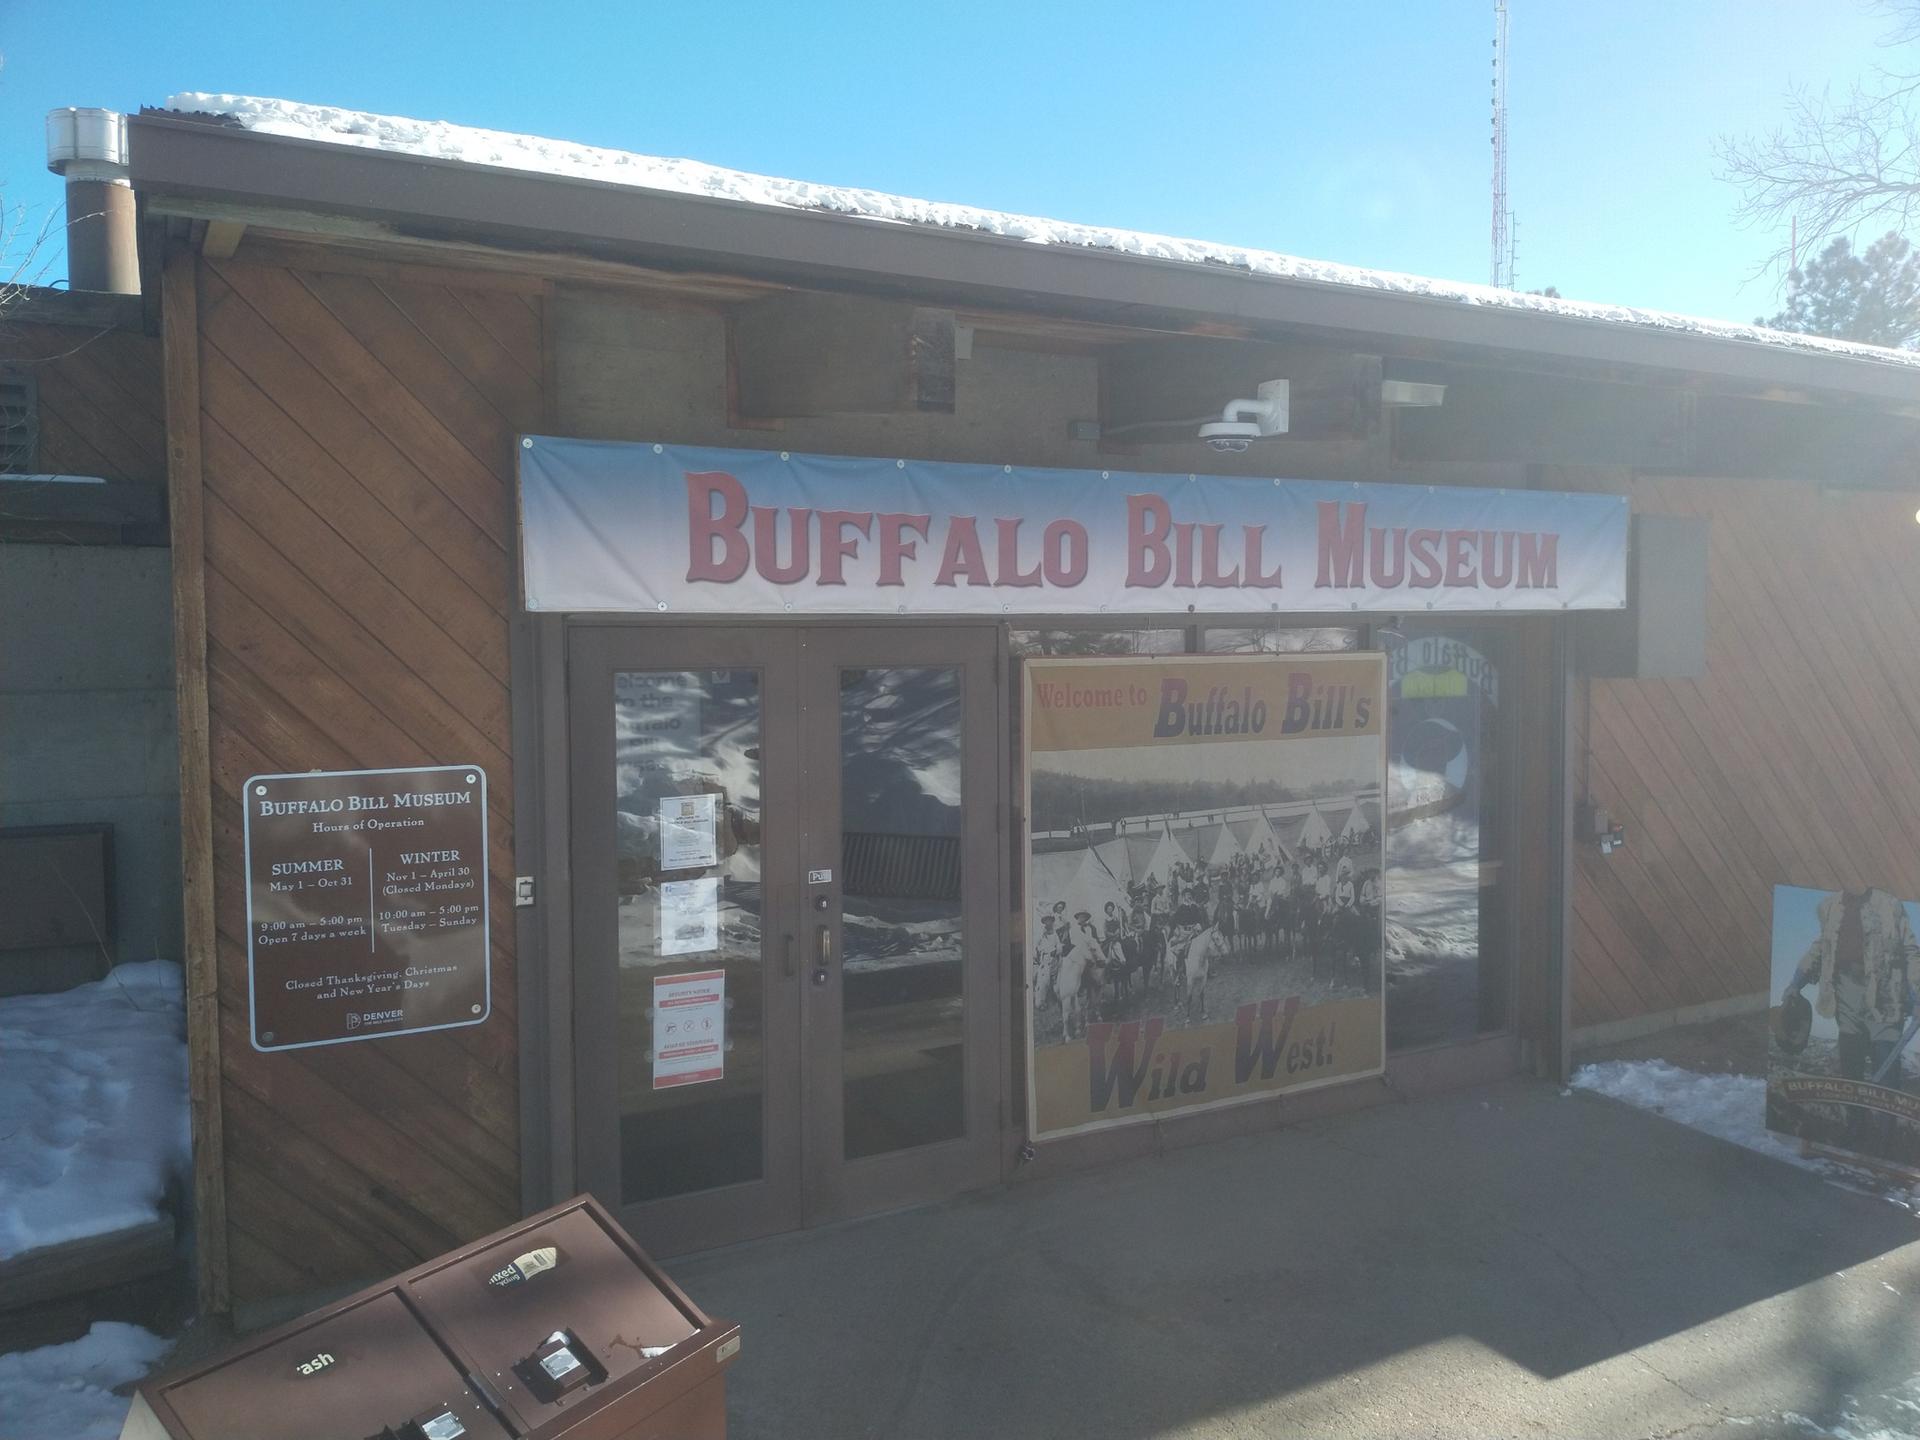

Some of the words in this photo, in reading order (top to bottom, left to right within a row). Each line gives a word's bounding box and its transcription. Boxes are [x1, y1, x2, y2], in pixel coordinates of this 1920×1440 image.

[685, 471, 1089, 588] BUFFALO
[1124, 493, 1283, 589] BILL
[1314, 501, 1560, 590] MUSEUM
[1036, 683, 1123, 709] Welcome
[1127, 683, 1147, 706] to
[1153, 678, 1265, 738] Buffalo
[1281, 672, 1372, 734] Bill's
[260, 799, 343, 817] BUFFALO
[348, 796, 388, 811] BILL
[393, 792, 471, 807] MUSEUM
[313, 822, 349, 833] Hours
[353, 820, 364, 830] of
[367, 817, 424, 831] Operation
[400, 850, 460, 865] WINTER
[272, 859, 344, 876] SUMMER
[386, 872, 408, 882] Nov
[411, 872, 416, 880] 1
[430, 868, 455, 879] April
[457, 867, 470, 876] 30
[269, 881, 295, 892] May
[298, 880, 303, 889] 1
[318, 878, 338, 888] Oct
[340, 876, 353, 886] 31
[382, 883, 421, 896] (Closed
[424, 879, 475, 892] Mondays)
[464, 905, 479, 913] pm
[346, 917, 363, 925] pm
[381, 922, 426, 933] Tuesday
[439, 916, 477, 927] Sunday
[258, 935, 288, 945] Open
[291, 932, 298, 942] 7
[301, 931, 326, 941] days
[339, 926, 367, 937] week
[285, 978, 323, 990] Closed
[405, 965, 458, 977] Christmas
[316, 990, 337, 1000] and
[340, 987, 365, 997] New
[367, 981, 401, 994] Year's
[404, 979, 430, 990] Days
[363, 1009, 404, 1022] DENVER
[1087, 1017, 1212, 1113] Wild
[1234, 996, 1337, 1084] West!
[1788, 1081, 1854, 1093] BUFFALO
[1857, 1087, 1889, 1101] BILL
